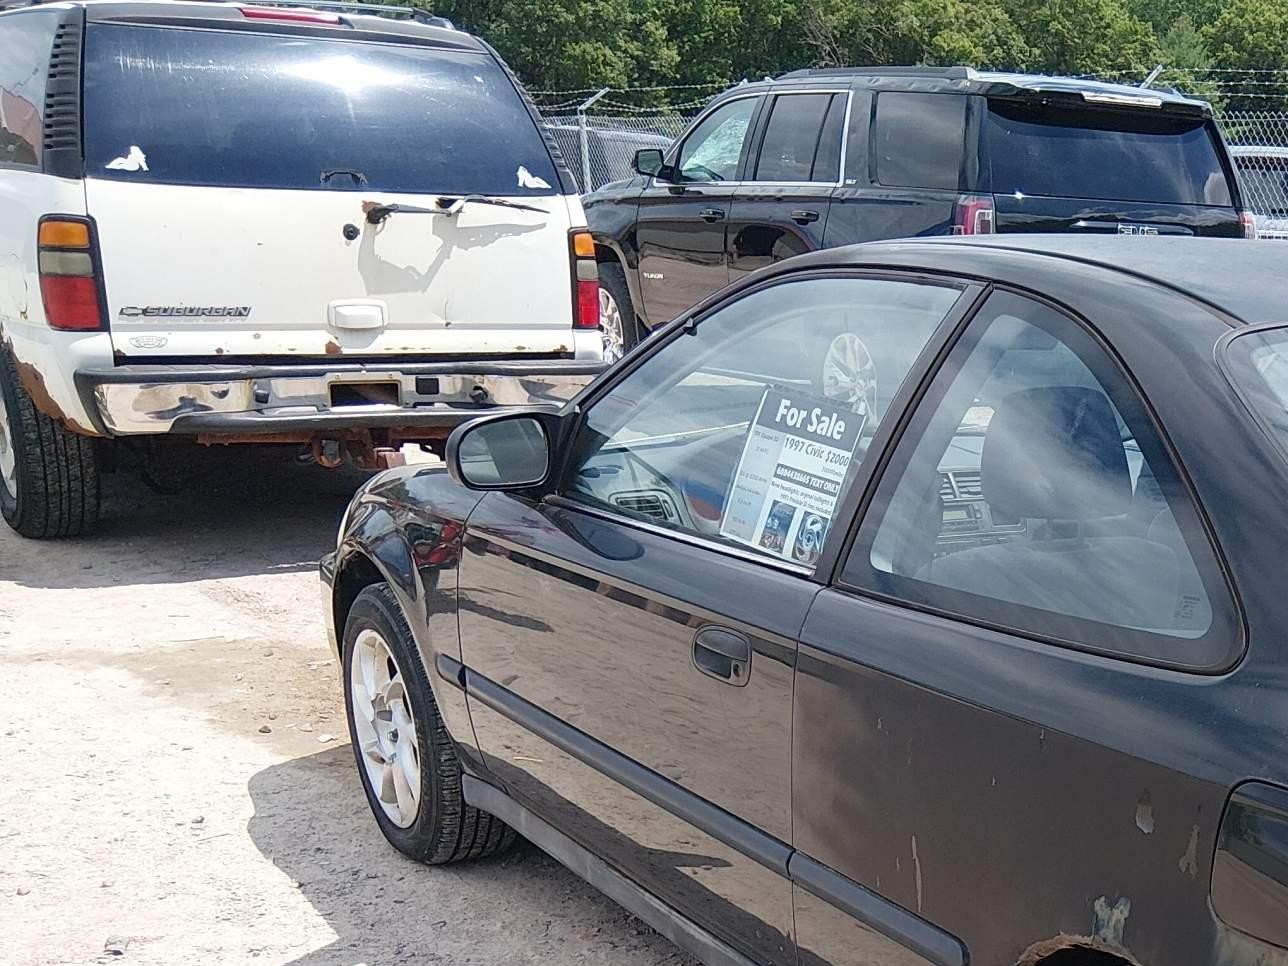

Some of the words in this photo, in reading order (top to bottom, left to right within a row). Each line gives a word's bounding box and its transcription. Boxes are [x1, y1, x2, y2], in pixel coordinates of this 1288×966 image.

[144, 305, 251, 317] SUBURBAN
[775, 399, 807, 428] For
[807, 407, 846, 440] Sale
[784, 437, 805, 453] 1997
[805, 443, 825, 459] Civic
[825, 449, 850, 467] $2000
